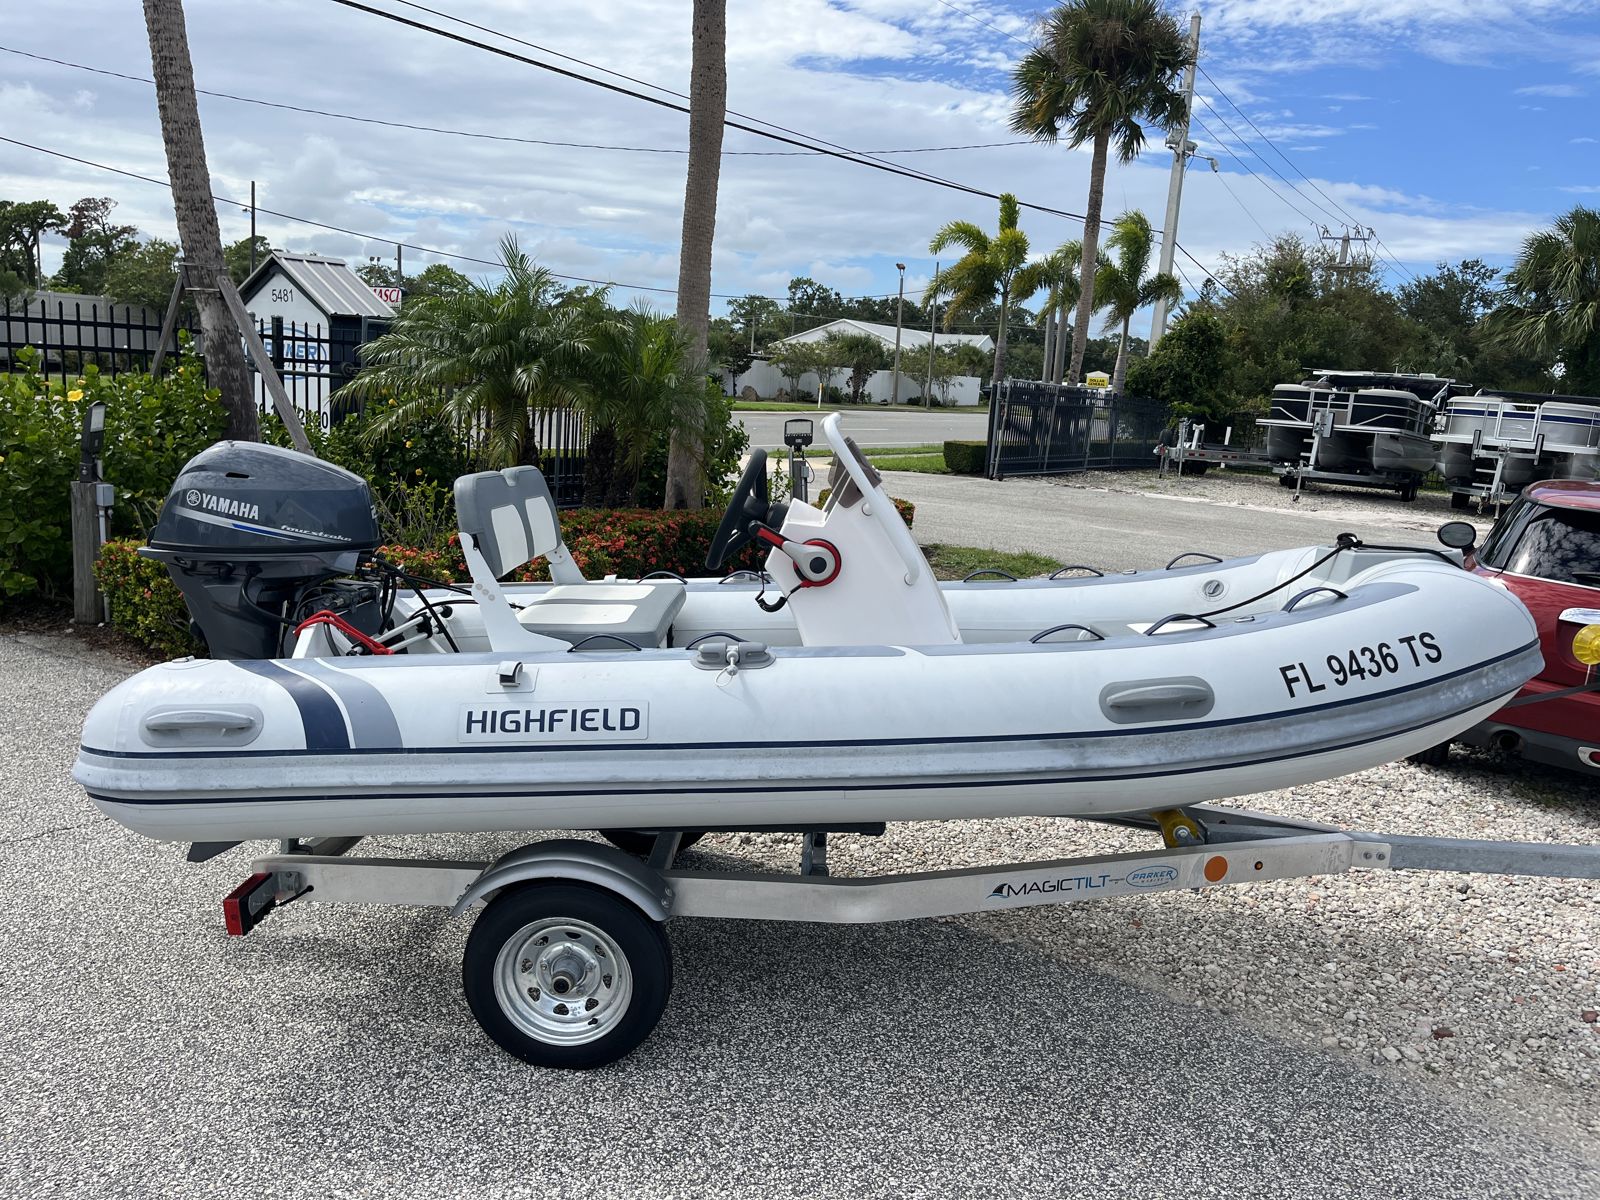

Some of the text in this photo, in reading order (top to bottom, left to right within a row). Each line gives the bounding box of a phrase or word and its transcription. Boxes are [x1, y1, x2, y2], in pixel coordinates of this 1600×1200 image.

[271, 288, 294, 303] 5481
[374, 288, 400, 303] ASCI
[202, 493, 259, 520] YAMAHA
[1279, 632, 1442, 698] FL 9436 TS
[466, 707, 640, 734] HIGHFIELD
[1007, 874, 1110, 897] MAGICTILT
[1132, 870, 1173, 881] PARKER
